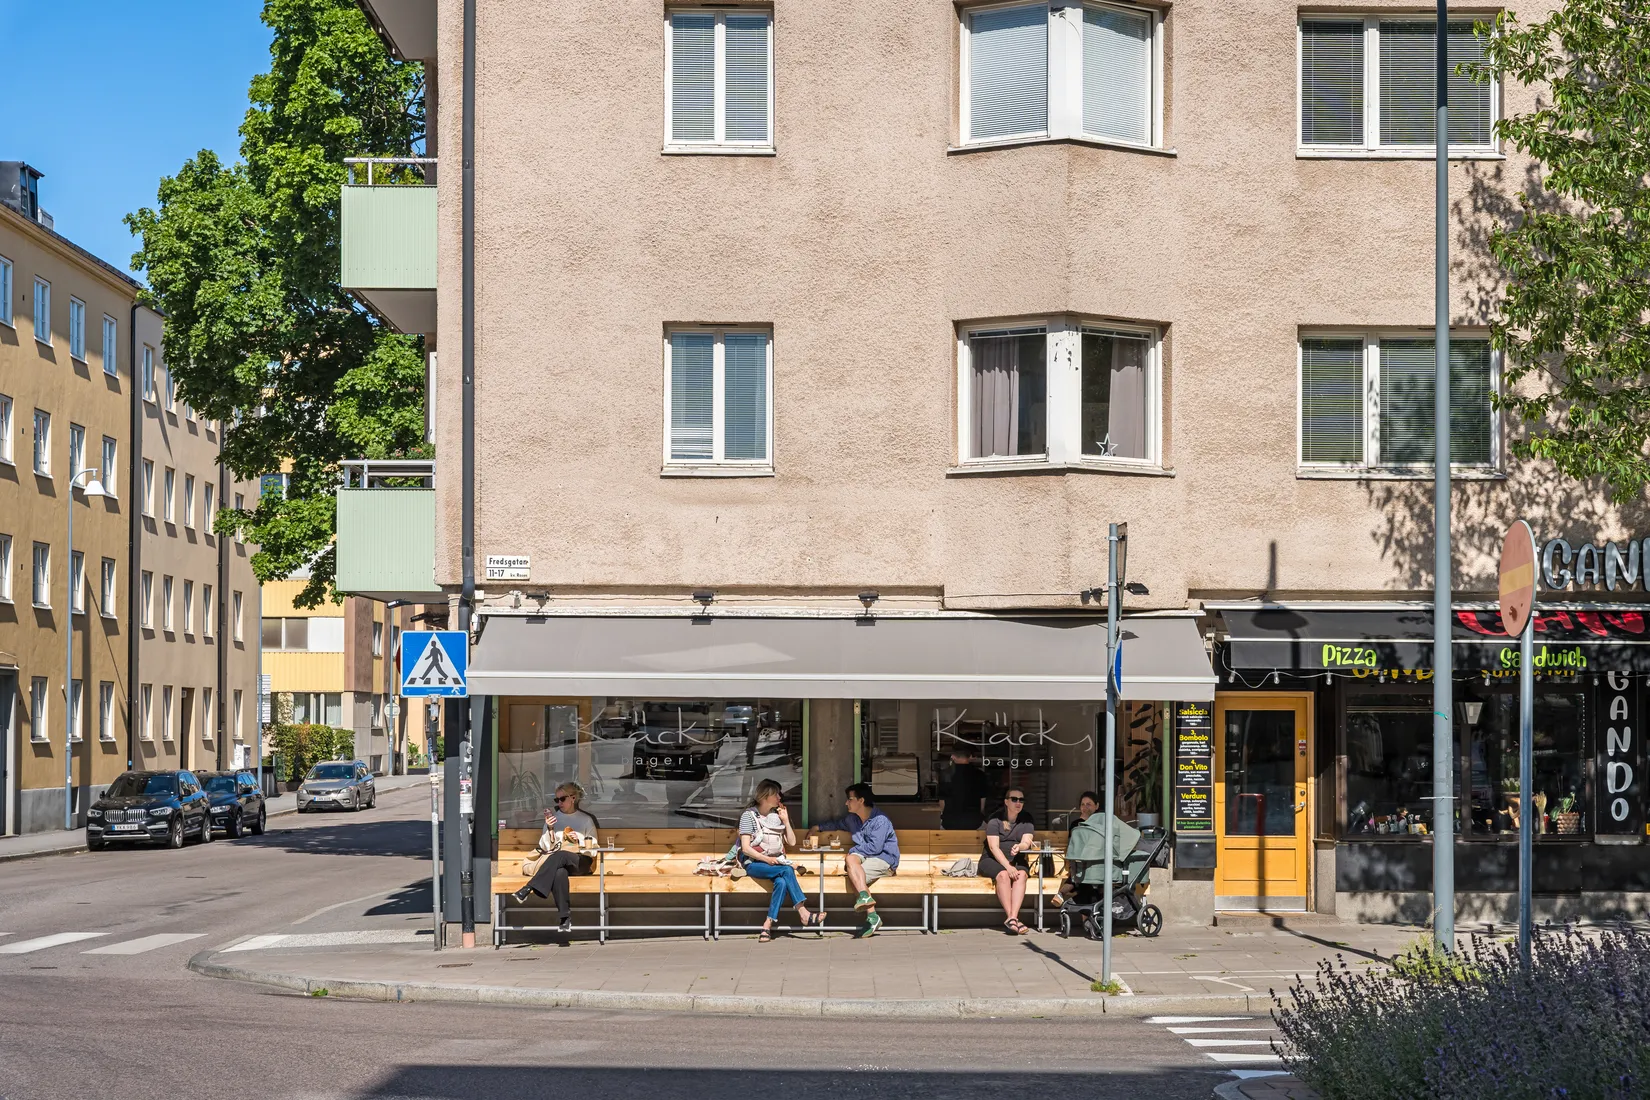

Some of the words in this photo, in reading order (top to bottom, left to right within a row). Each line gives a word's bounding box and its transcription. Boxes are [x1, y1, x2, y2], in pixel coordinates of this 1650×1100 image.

[489, 557, 528, 567] Fredsgatan
[489, 569, 504, 577] 11-17
[1322, 643, 1377, 667] Pizza
[1500, 645, 1587, 668] Sadwich
[933, 708, 1093, 752] Käcks
[982, 756, 1054, 769] bageri
